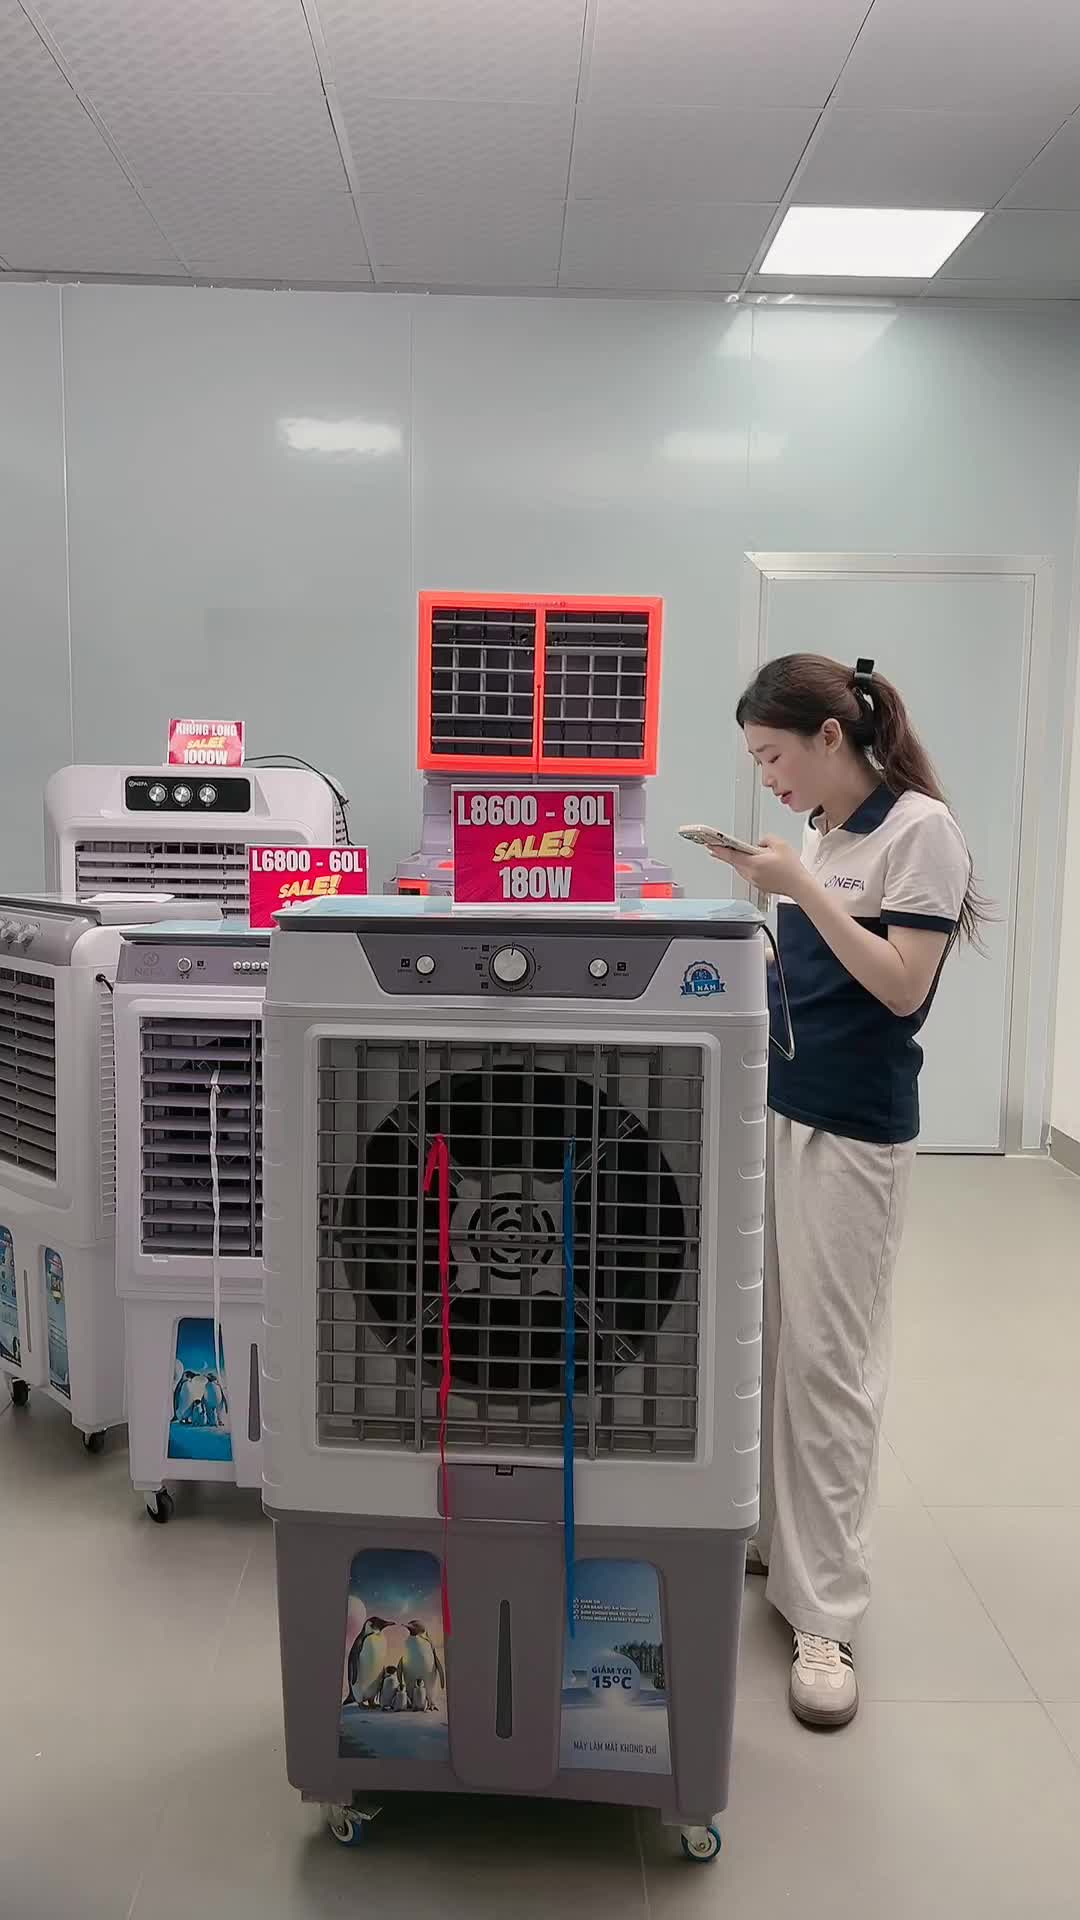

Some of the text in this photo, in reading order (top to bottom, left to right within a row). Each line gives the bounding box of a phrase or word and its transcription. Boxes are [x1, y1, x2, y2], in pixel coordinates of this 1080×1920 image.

[183, 749, 229, 765] 1000W
[457, 795, 538, 826] L8600
[563, 795, 611, 826] 80L
[491, 828, 581, 863] SALE!
[252, 849, 311, 872] L6800
[329, 850, 363, 873] 60L
[278, 874, 343, 899] SALE!
[499, 866, 572, 899] 180W
